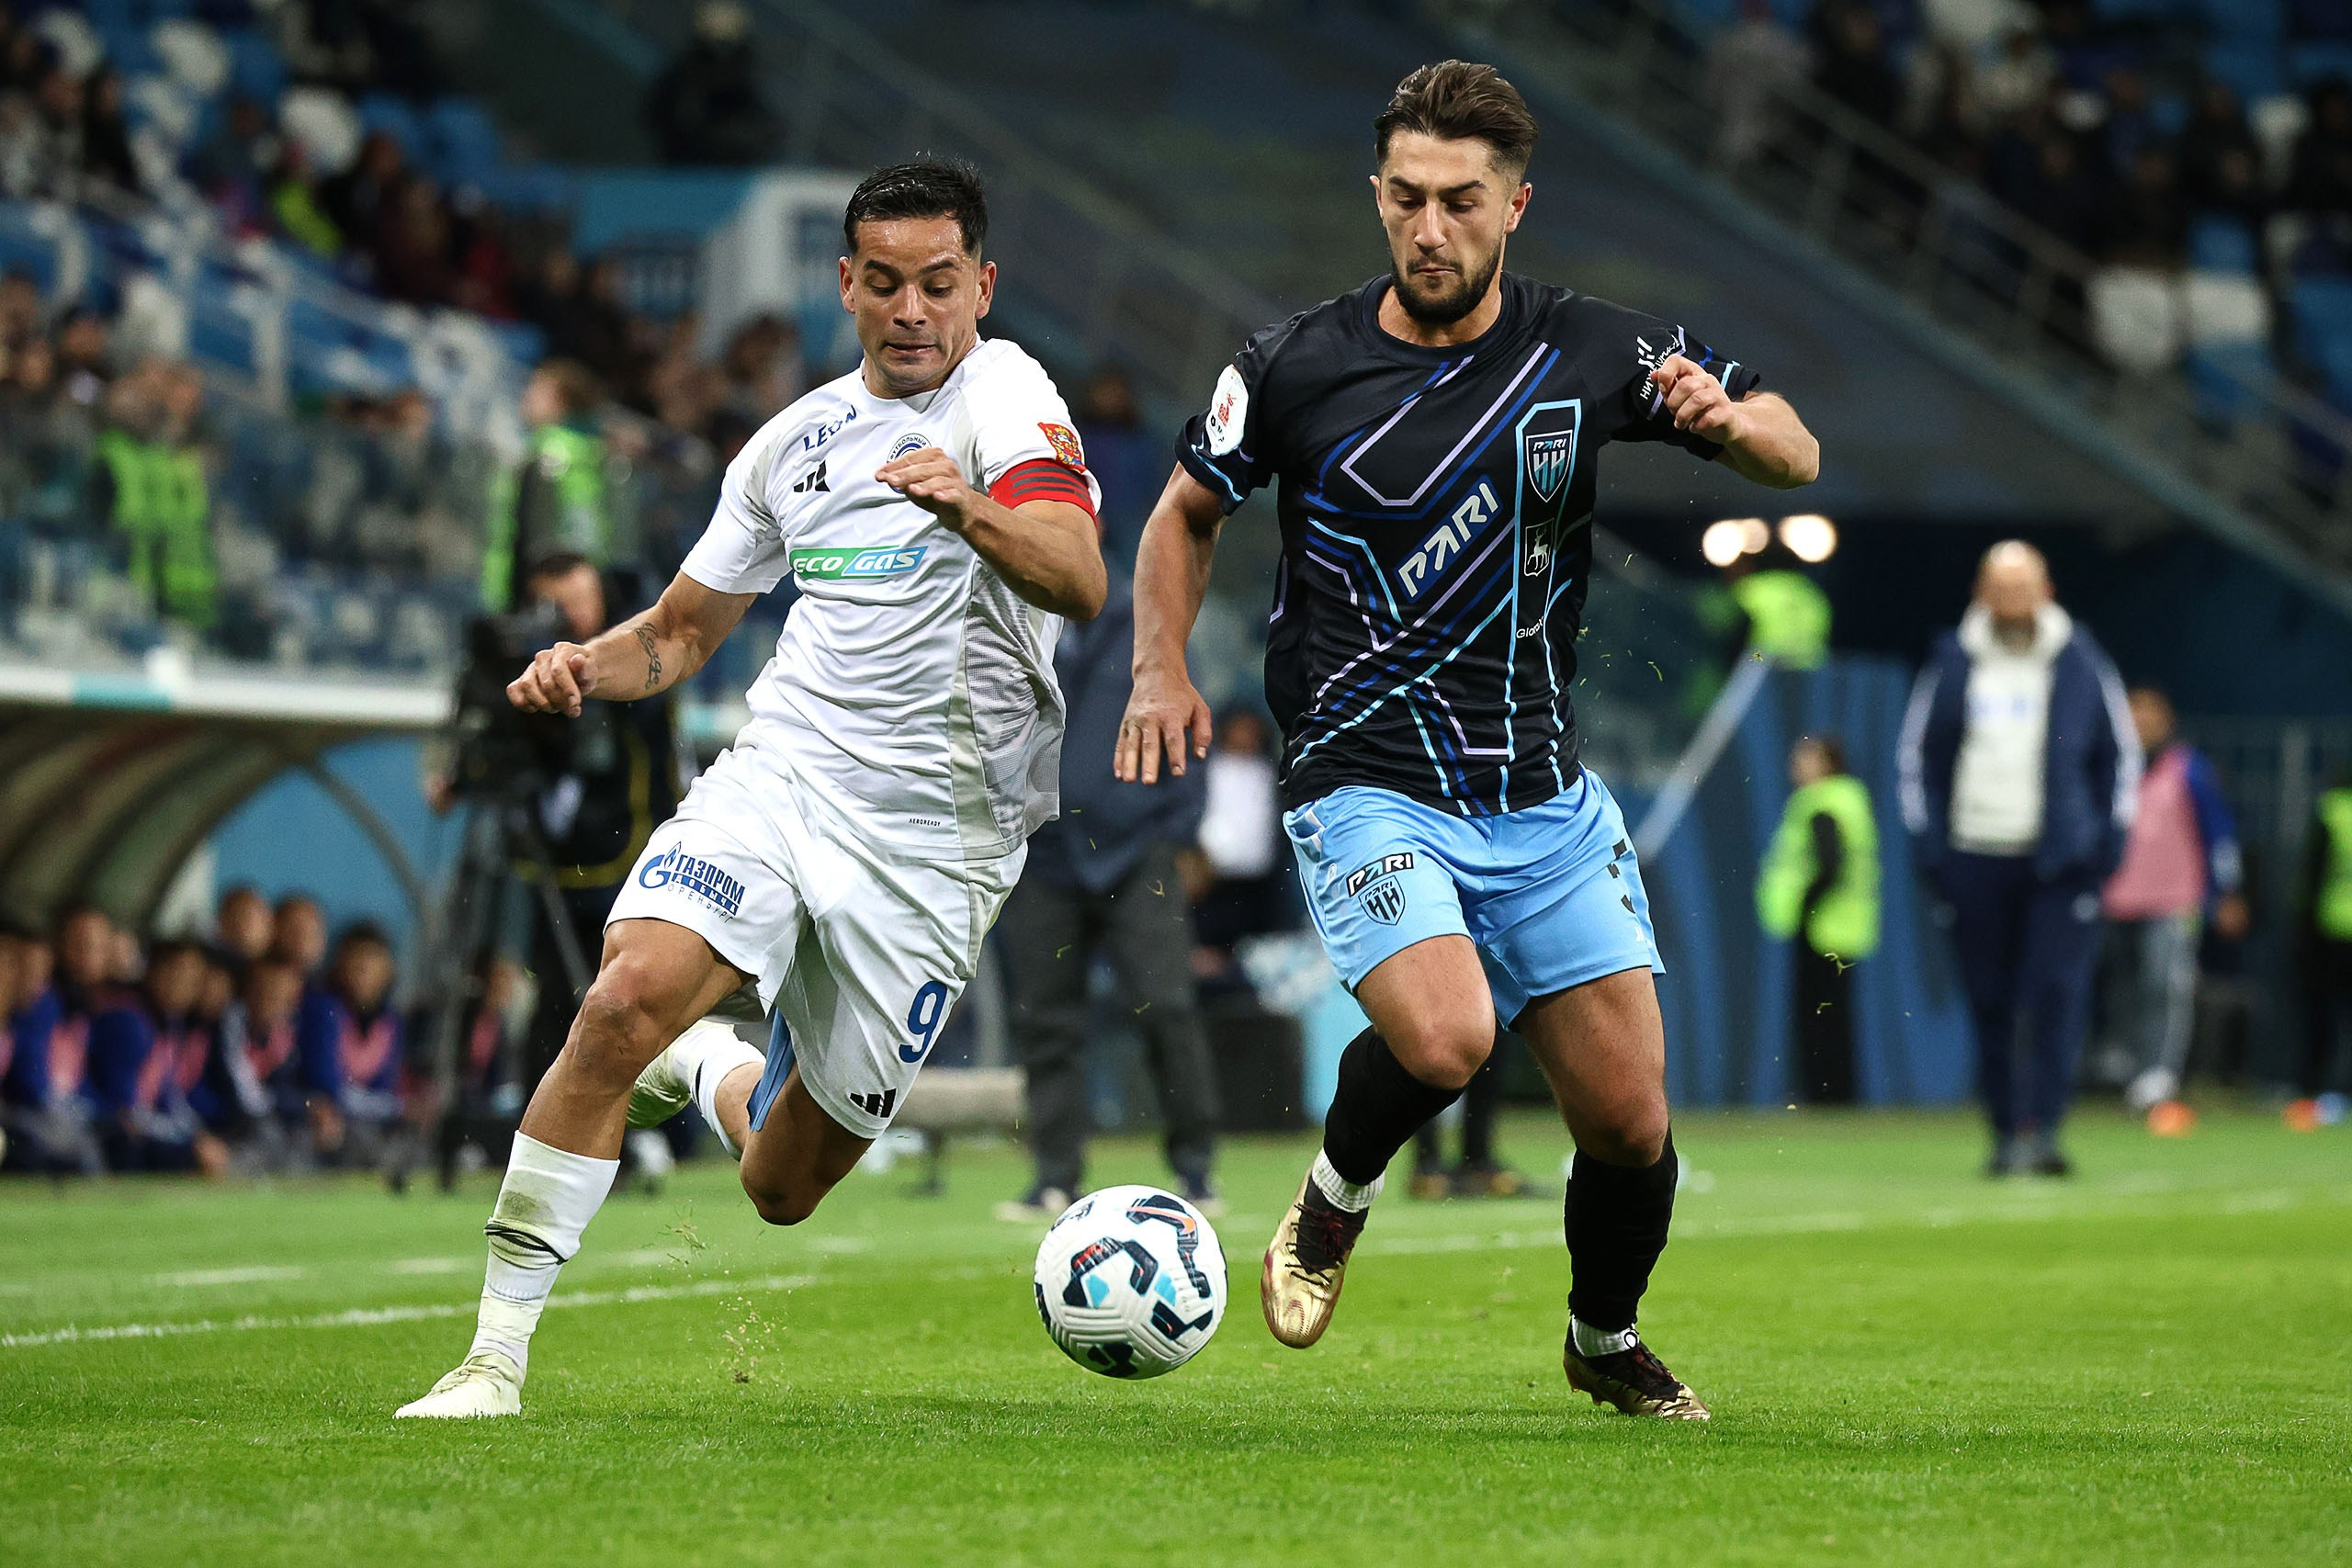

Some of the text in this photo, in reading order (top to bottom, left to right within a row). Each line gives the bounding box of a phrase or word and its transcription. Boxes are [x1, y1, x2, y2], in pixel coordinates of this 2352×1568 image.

[804, 404, 857, 451] LEON
[1532, 438, 1567, 451] PARI
[1398, 482, 1498, 597] PARI
[793, 556, 844, 573] ECO
[909, 818, 941, 827] AEROREADY
[673, 873, 738, 915] ДОБЫЧА
[675, 853, 746, 905] ГАЗПРОМ
[1348, 853, 1412, 897] PARI
[1364, 881, 1393, 901] PARI
[667, 883, 734, 923] ОРЕНБУРГ
[898, 980, 948, 1064] 9
